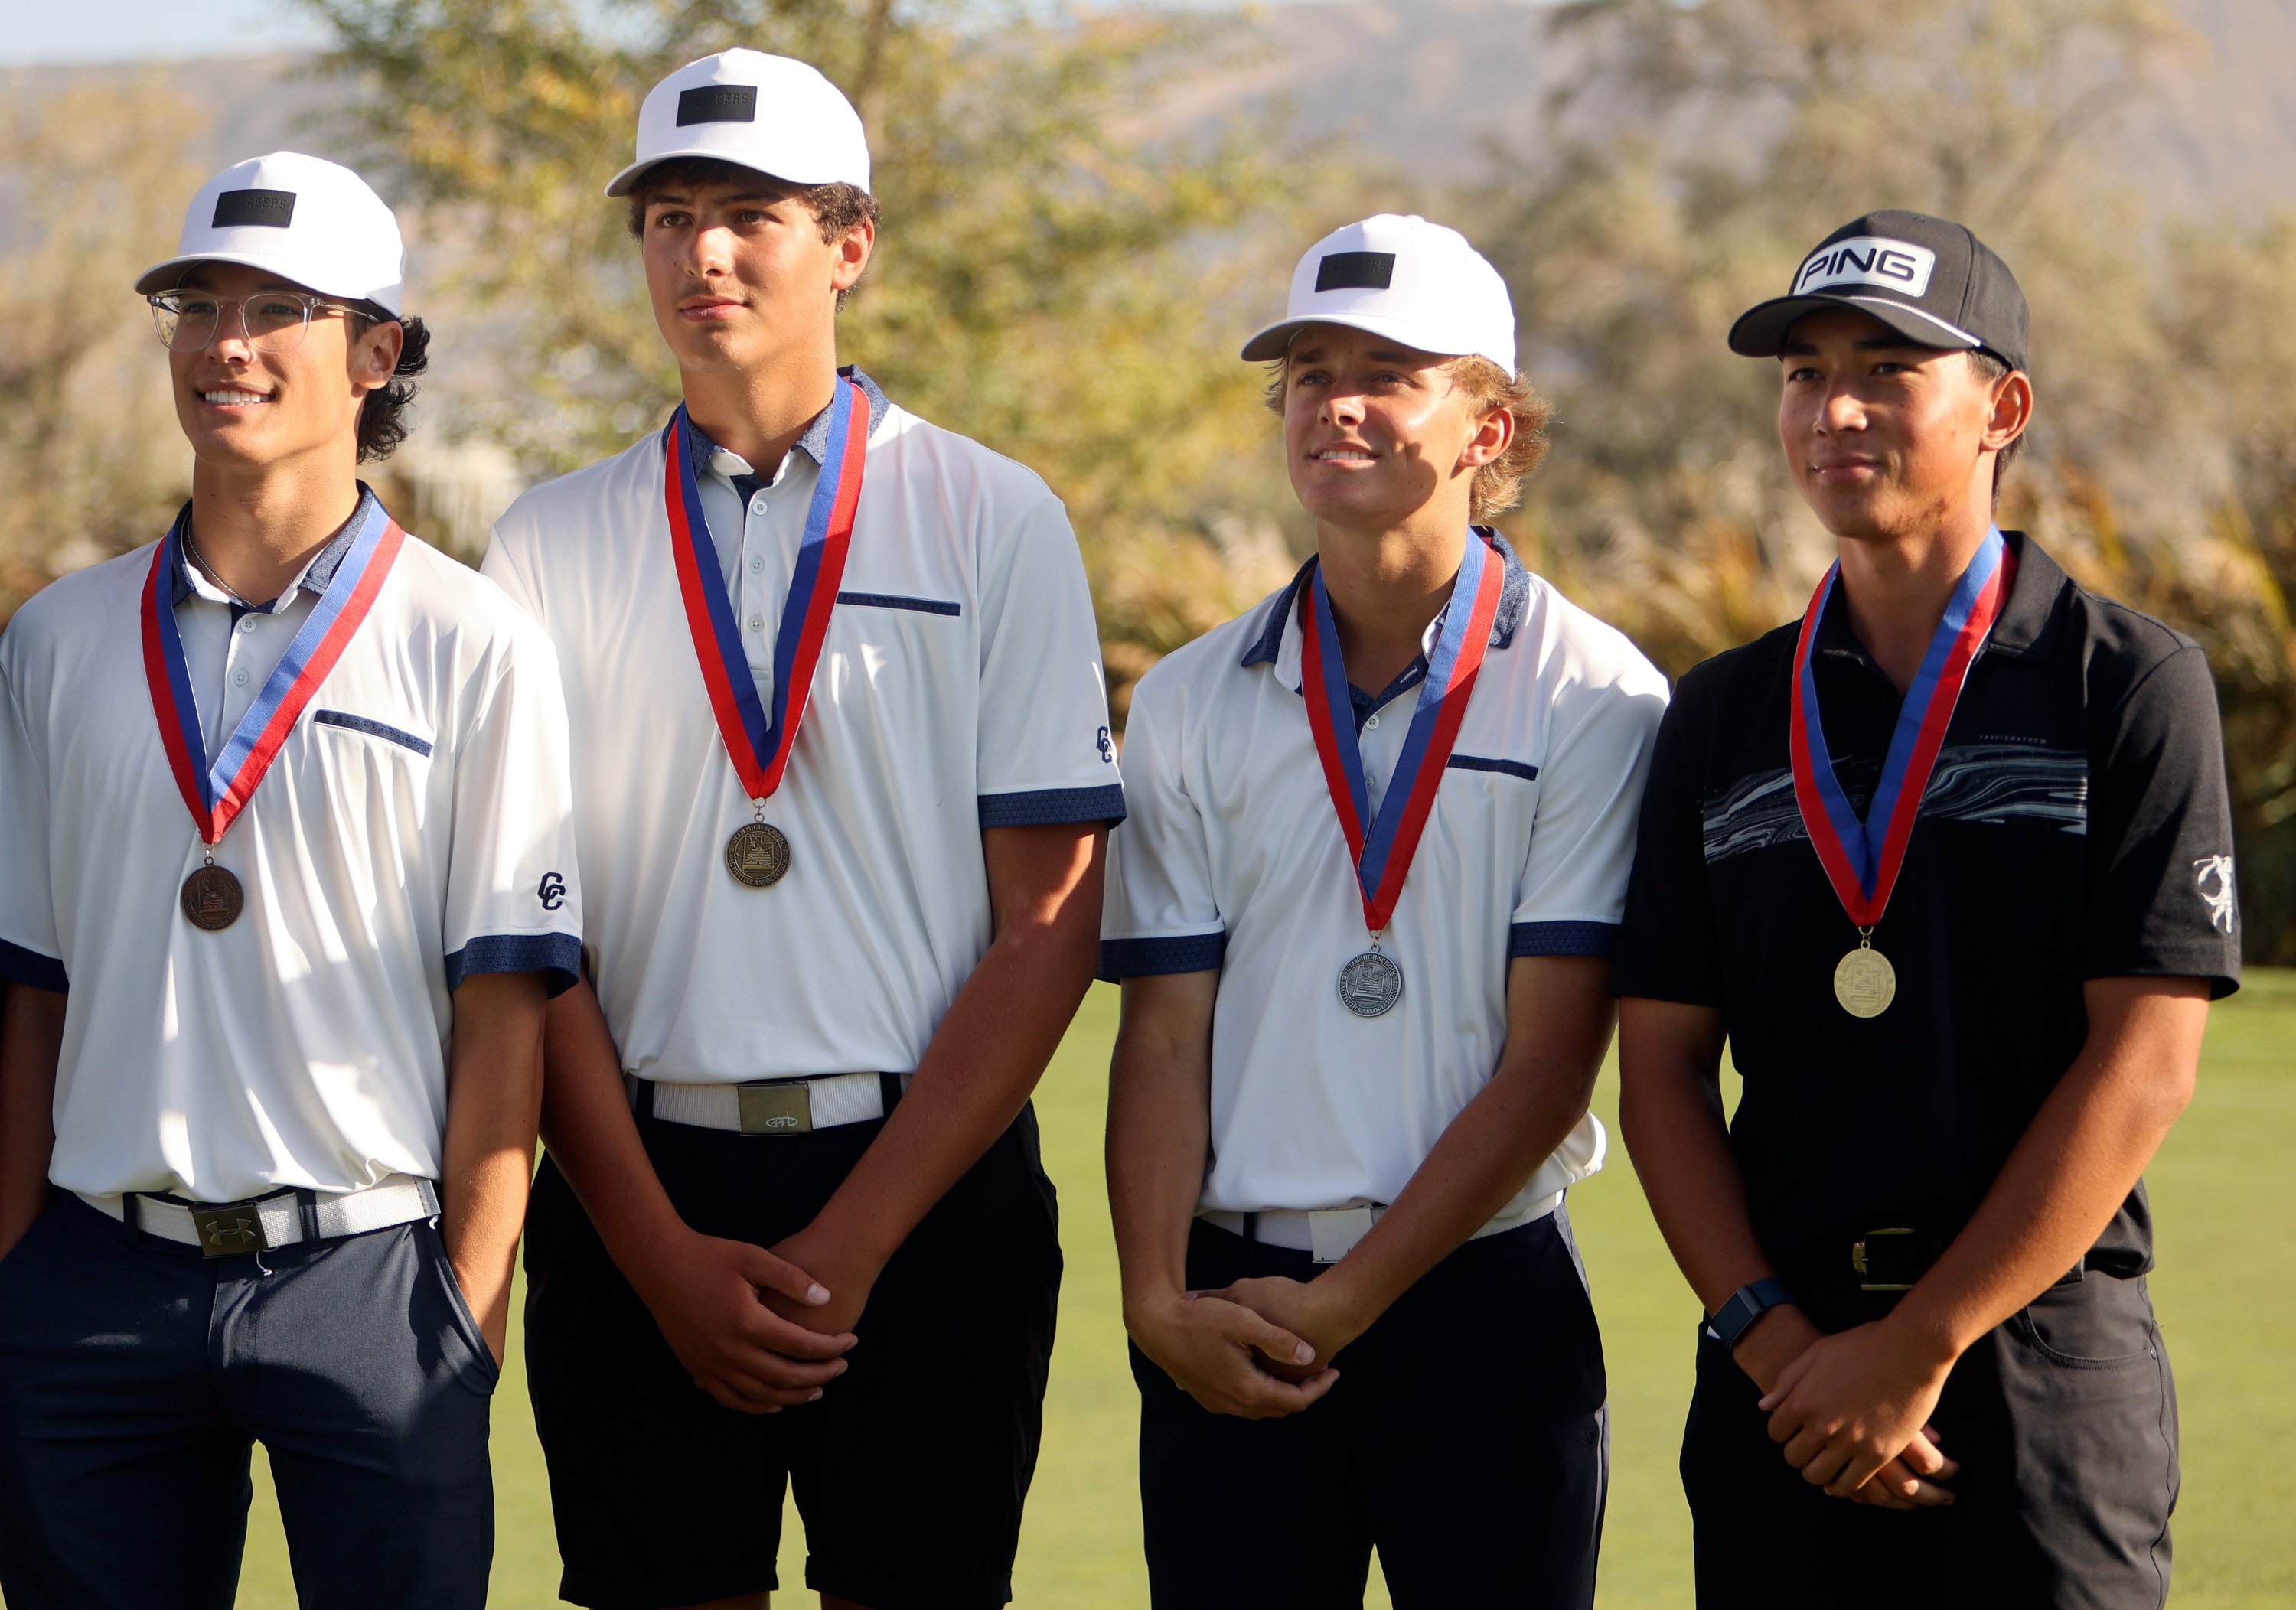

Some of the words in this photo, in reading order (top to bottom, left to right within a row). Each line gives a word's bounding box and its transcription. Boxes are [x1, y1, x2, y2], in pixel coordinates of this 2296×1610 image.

[1800, 248, 1916, 290] PING
[1979, 735, 2048, 745] TRAVISMATHEW
[731, 829, 745, 843] UTAH
[745, 824, 763, 833] HIGH
[764, 826, 786, 846] SCHOOL
[728, 858, 754, 885] ACTIVITIES
[754, 859, 788, 886] ASSOCIATION
[537, 872, 566, 910] CC
[1345, 958, 1360, 972] UTAH
[1378, 956, 1397, 977] SCHOOL
[1340, 984, 1362, 1013] ACTIVITIES
[1362, 989, 1397, 1014] ASSOCIATION
